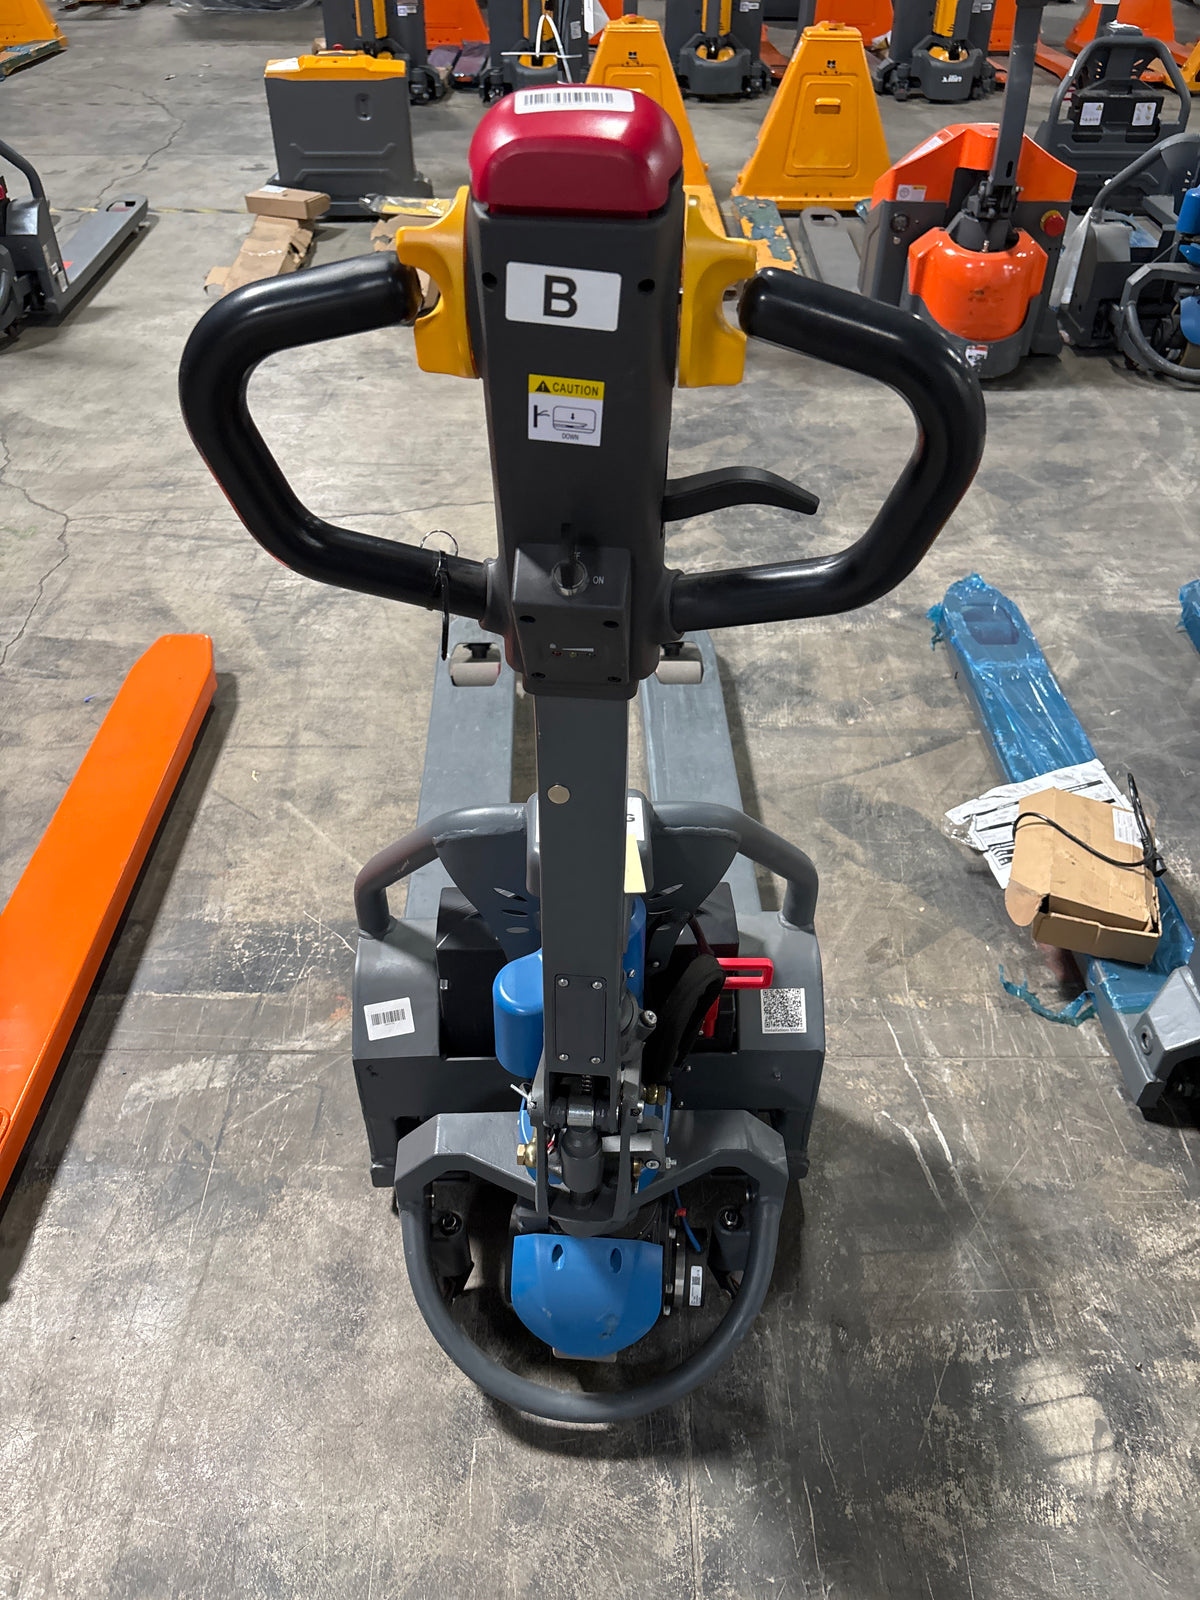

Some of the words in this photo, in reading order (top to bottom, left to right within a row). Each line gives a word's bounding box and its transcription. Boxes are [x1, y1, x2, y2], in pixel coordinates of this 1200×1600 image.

[543, 274, 578, 318] B
[552, 382, 599, 396] CAUTION
[561, 432, 580, 441] DOWN
[592, 575, 605, 585] ON
